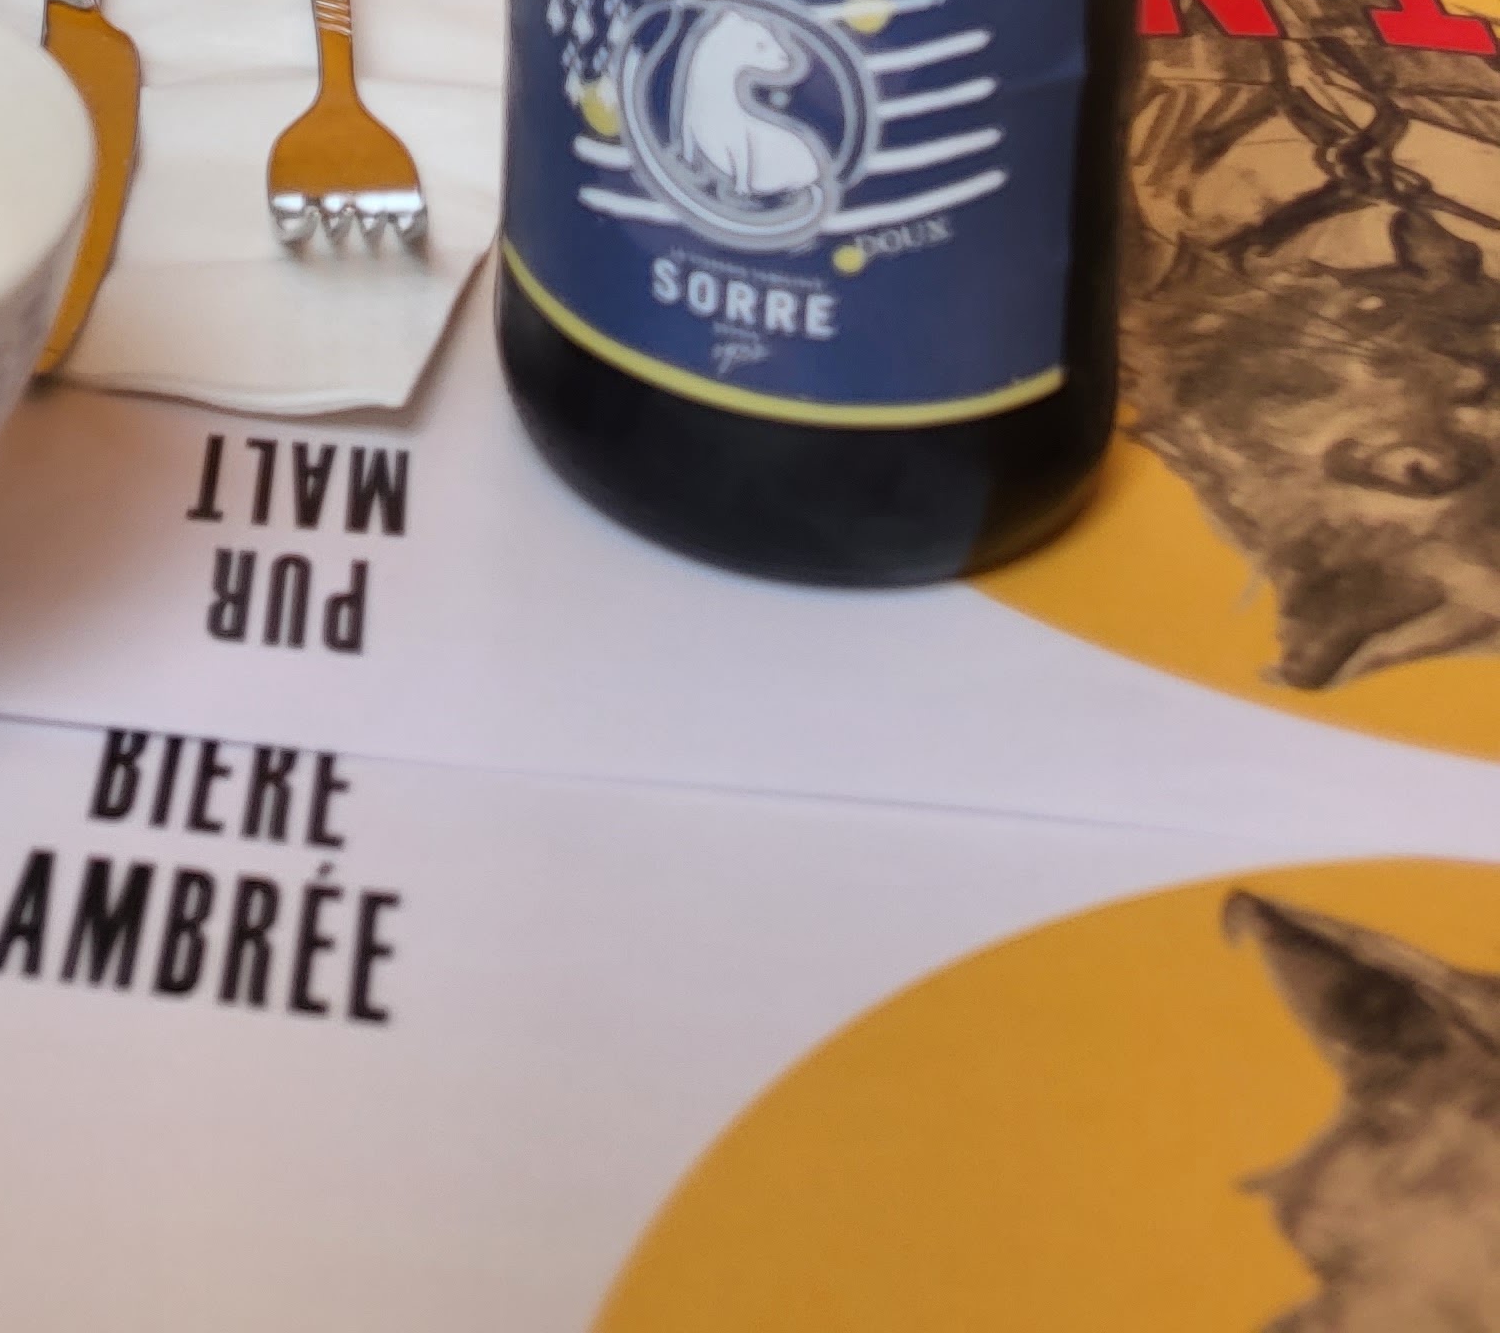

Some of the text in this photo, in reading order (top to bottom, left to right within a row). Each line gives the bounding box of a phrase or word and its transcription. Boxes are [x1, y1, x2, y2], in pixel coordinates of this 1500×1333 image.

[651, 255, 841, 341] SORRE
[187, 433, 410, 537] MALT
[207, 547, 369, 655] PUR
